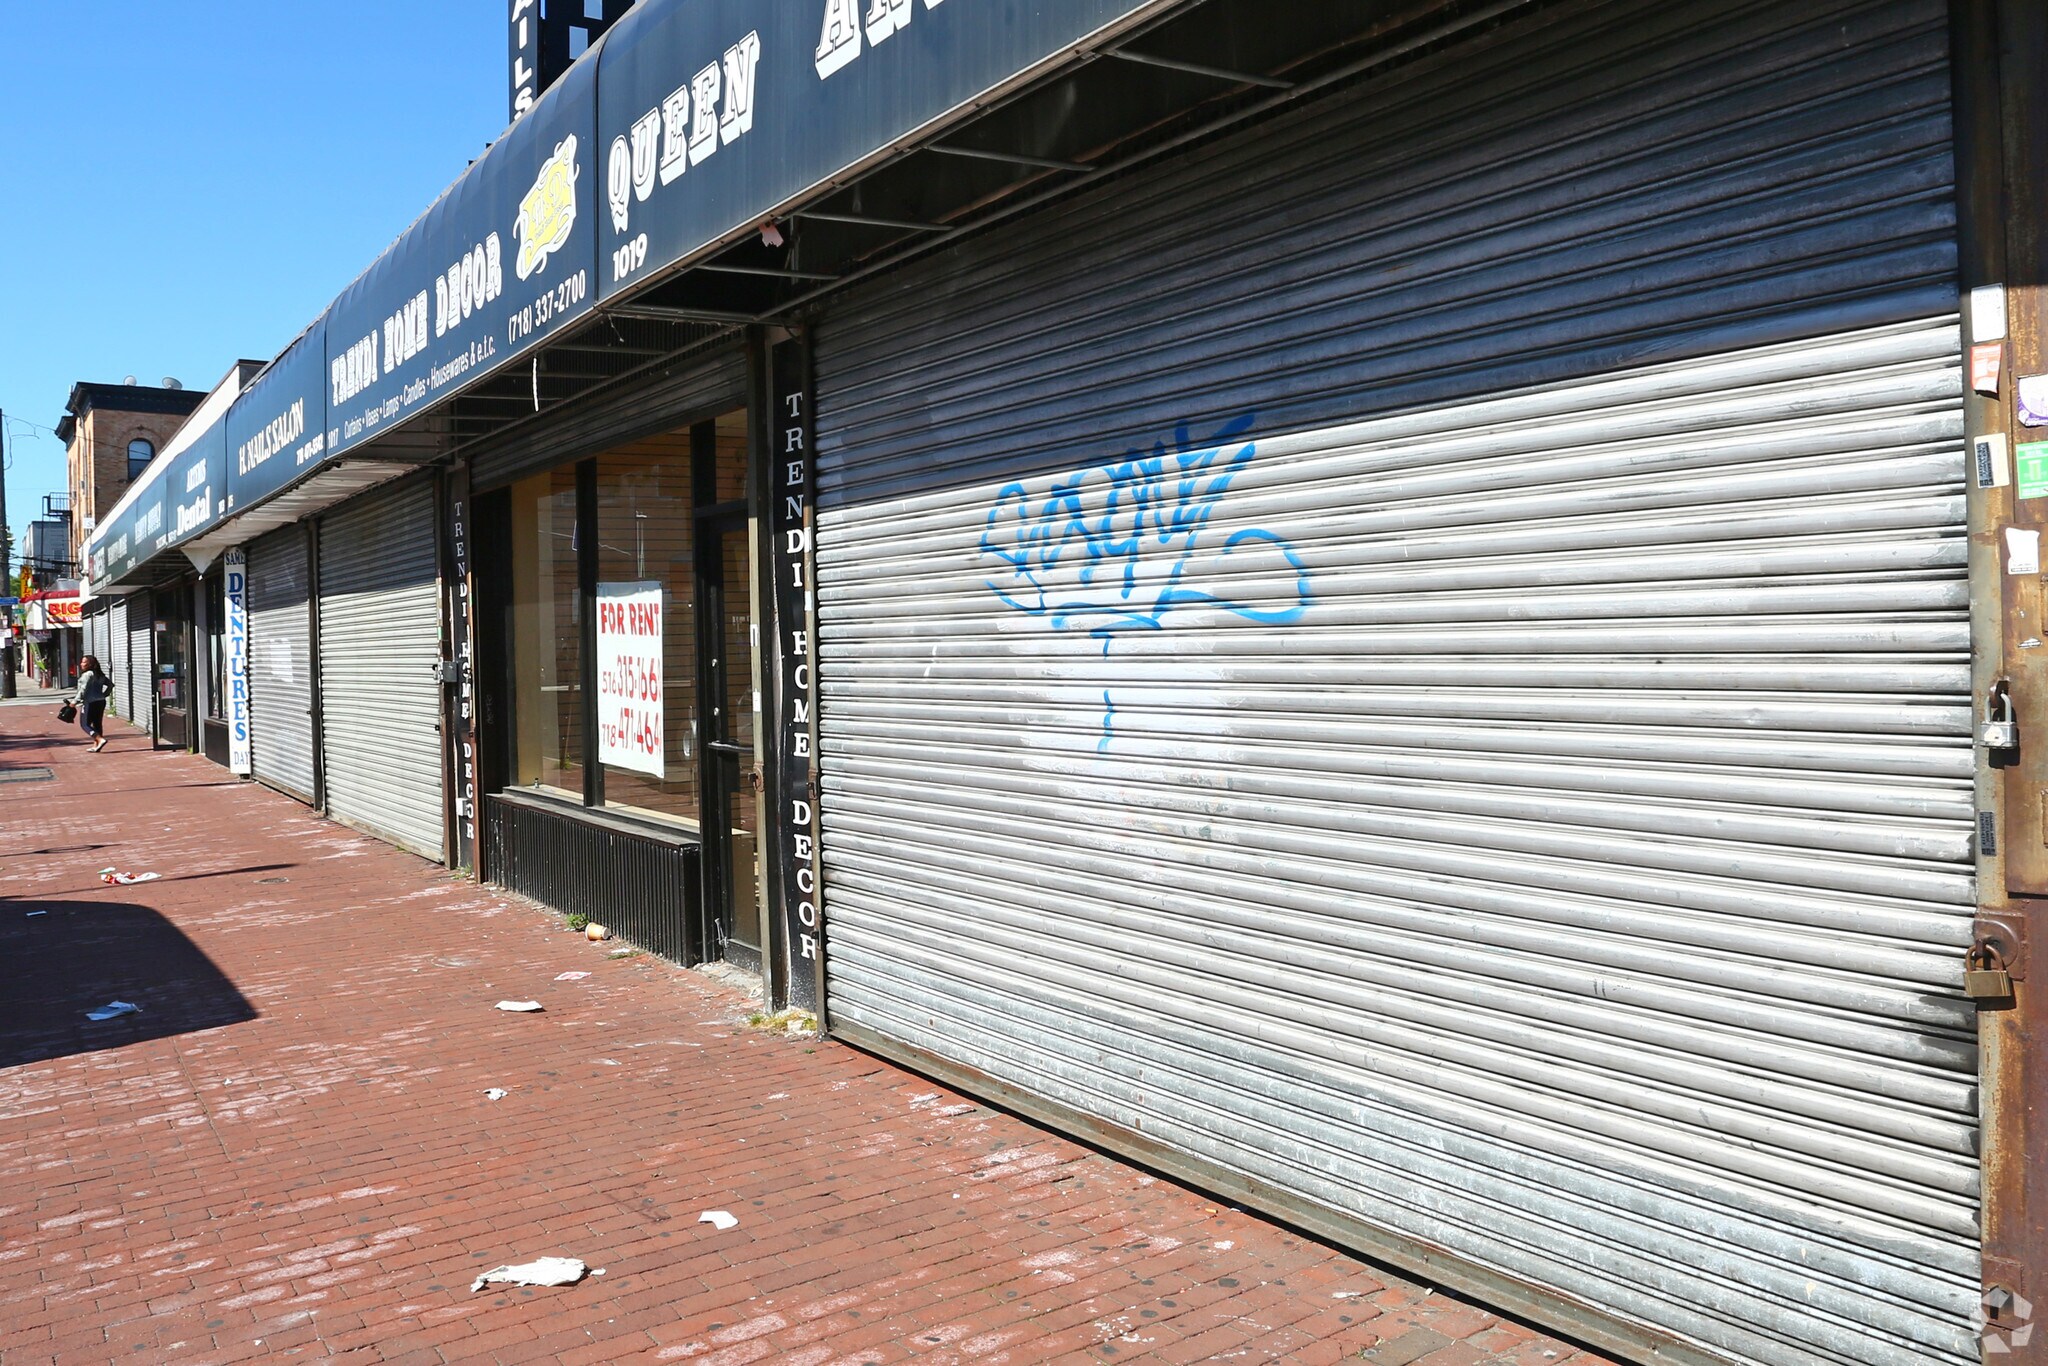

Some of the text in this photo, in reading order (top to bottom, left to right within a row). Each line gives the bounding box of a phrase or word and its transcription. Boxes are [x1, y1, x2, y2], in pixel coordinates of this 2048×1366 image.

[607, 29, 761, 235] QUEEN
[612, 232, 648, 282] 1019
[331, 231, 502, 407] TRENDI HOME DECOR
[508, 268, 586, 345] (718) 337-2700
[382, 395, 399, 419] Lamps
[403, 377, 426, 407] Candles
[430, 351, 469, 390] Housewares
[470, 341, 476, 367] &
[246, 424, 272, 472] NAILS
[272, 396, 304, 455] SALON
[177, 488, 210, 537] Dental
[785, 391, 806, 588] TRENDI
[455, 501, 469, 618] TRENDI
[48, 602, 83, 616] BIG
[600, 602, 660, 637] FOR RENT
[228, 572, 247, 742] DENTURES
[601, 655, 662, 703] 516 315-166
[233, 750, 250, 766] DAY
[601, 707, 662, 756] 718 471-464
[792, 800, 817, 960] DECOR
